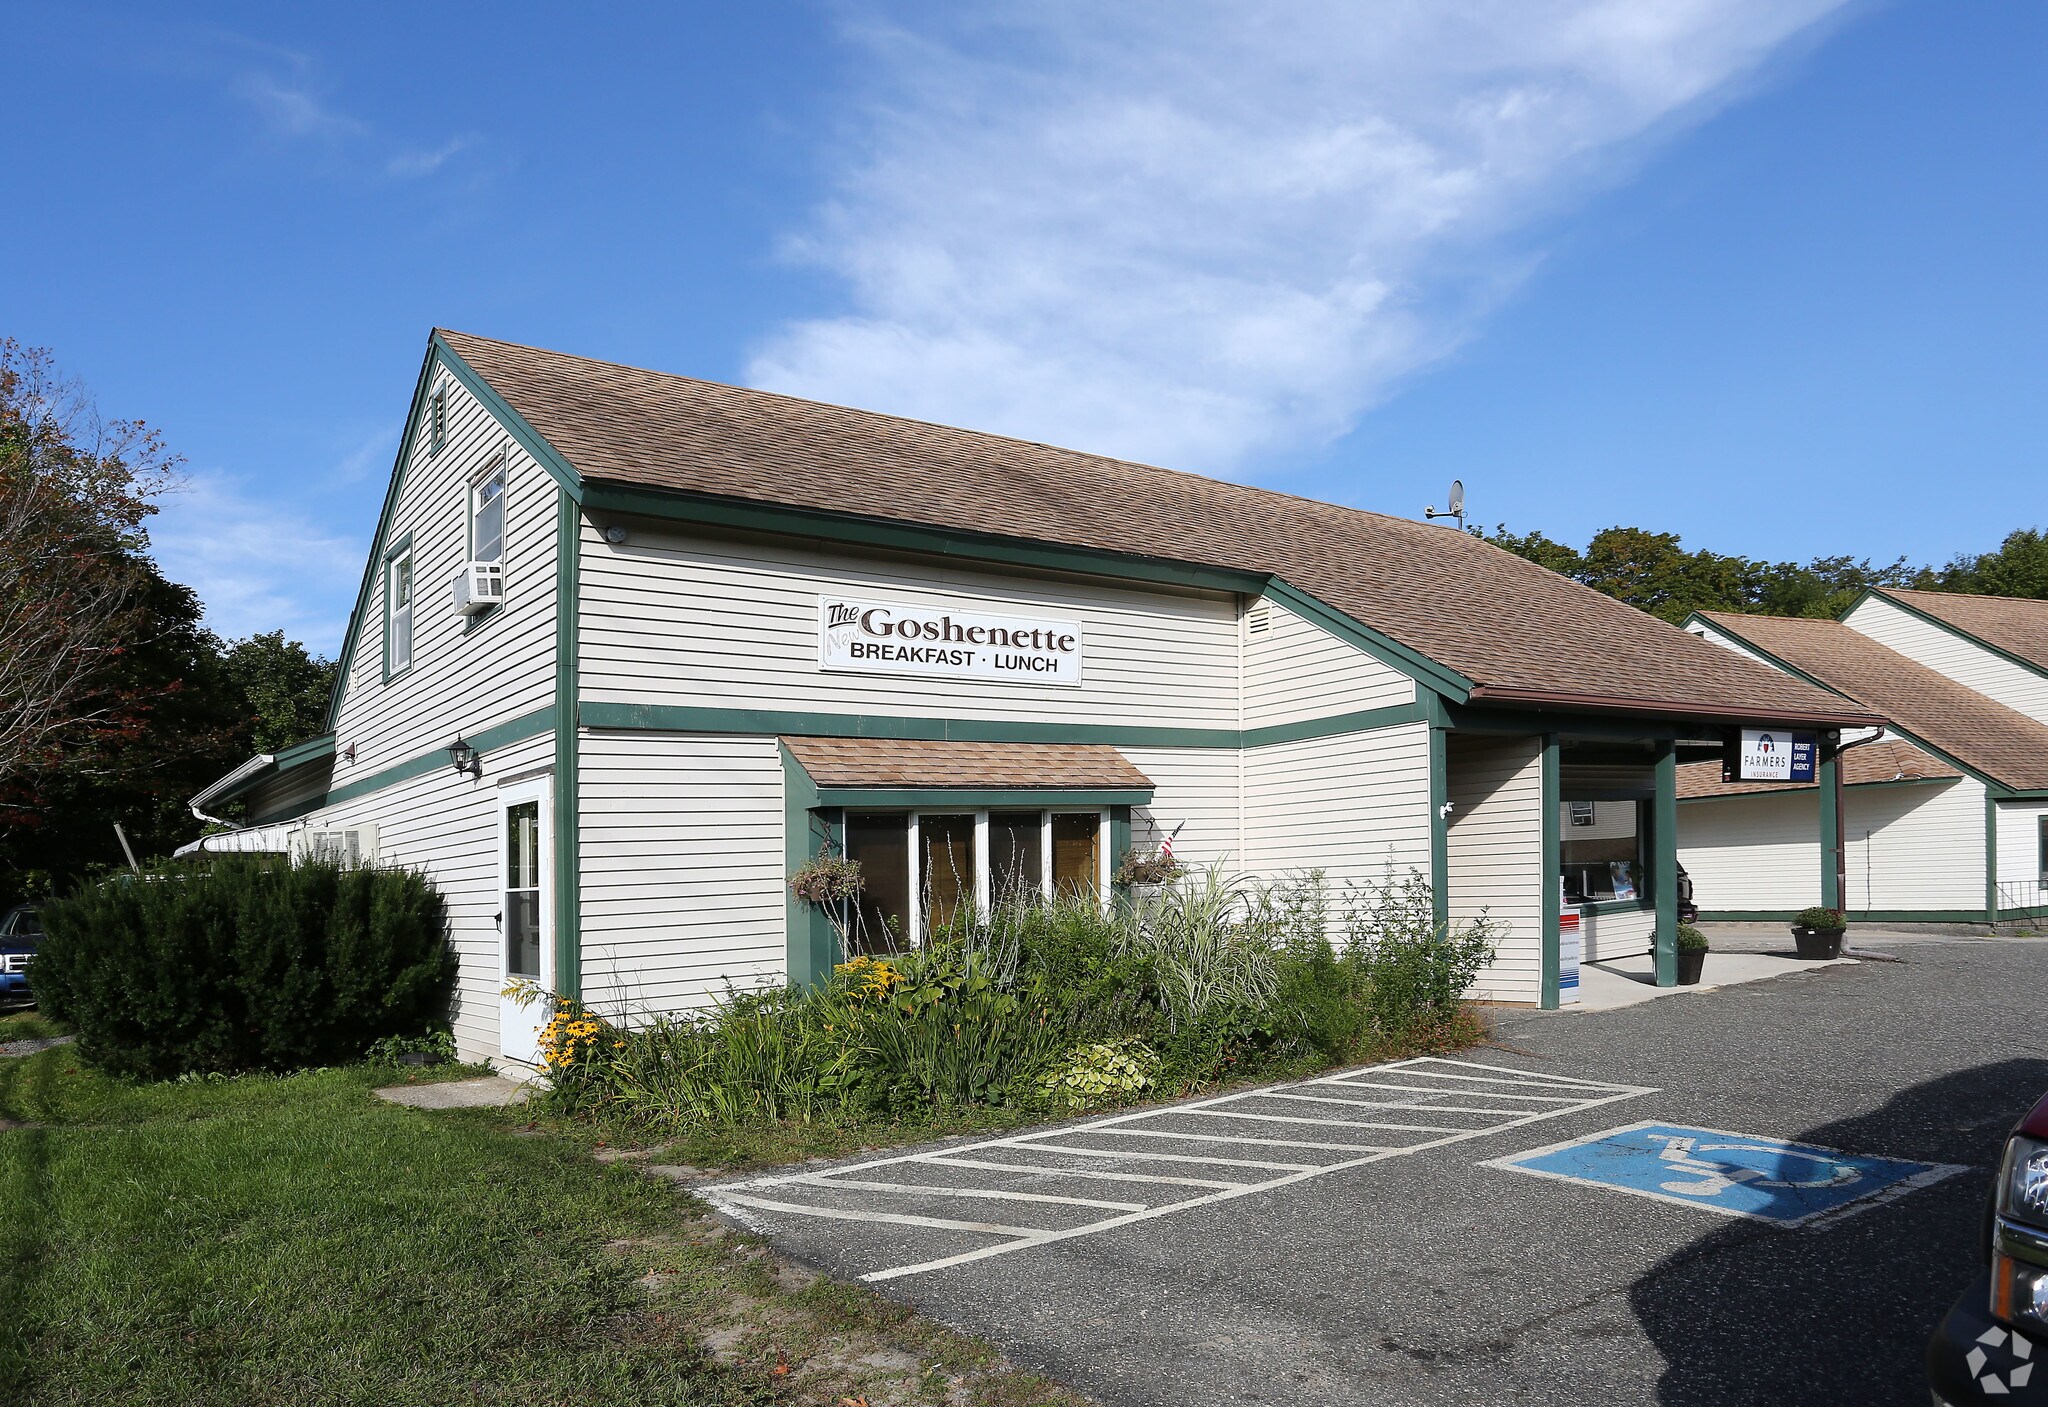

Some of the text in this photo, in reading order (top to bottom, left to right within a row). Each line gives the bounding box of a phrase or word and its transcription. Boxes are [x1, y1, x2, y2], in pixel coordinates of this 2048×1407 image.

[828, 603, 1075, 652] The Goshenette
[850, 642, 1058, 673] BREAKFAST LUNCH
[1745, 756, 1785, 767] FARMERS
